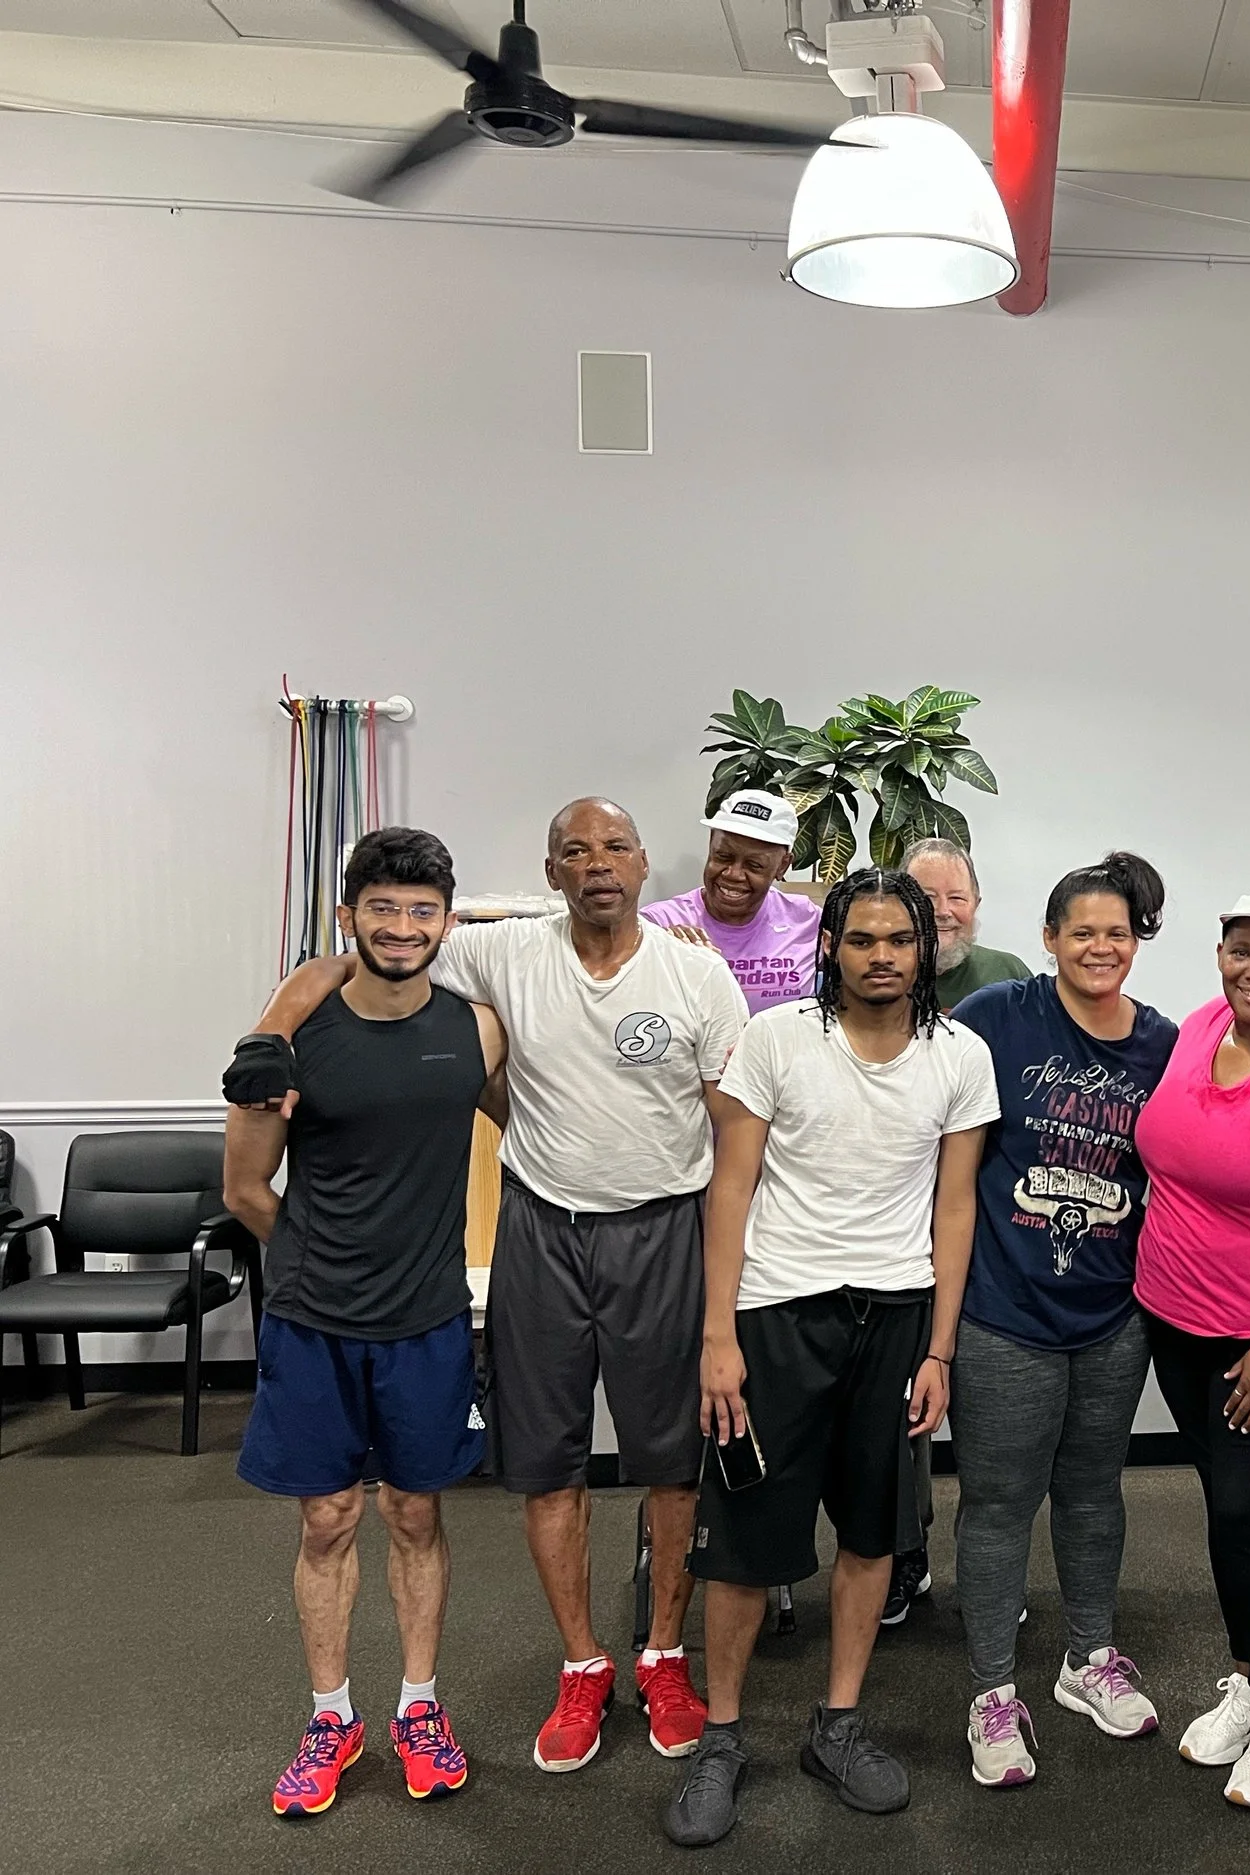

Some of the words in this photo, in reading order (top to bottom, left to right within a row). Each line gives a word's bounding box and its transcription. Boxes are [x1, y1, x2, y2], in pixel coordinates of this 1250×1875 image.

[734, 803, 771, 819] BELIEVE
[727, 956, 795, 971] partan
[735, 970, 801, 987] ndays
[760, 990, 781, 998] Run
[783, 988, 802, 997] Club
[1048, 1087, 1132, 1134] CASINO
[1057, 1121, 1095, 1142] HAND
[1039, 1134, 1120, 1176] SALOON
[1012, 1212, 1047, 1229] AUSTIN
[1091, 1227, 1119, 1239] TEXAS
